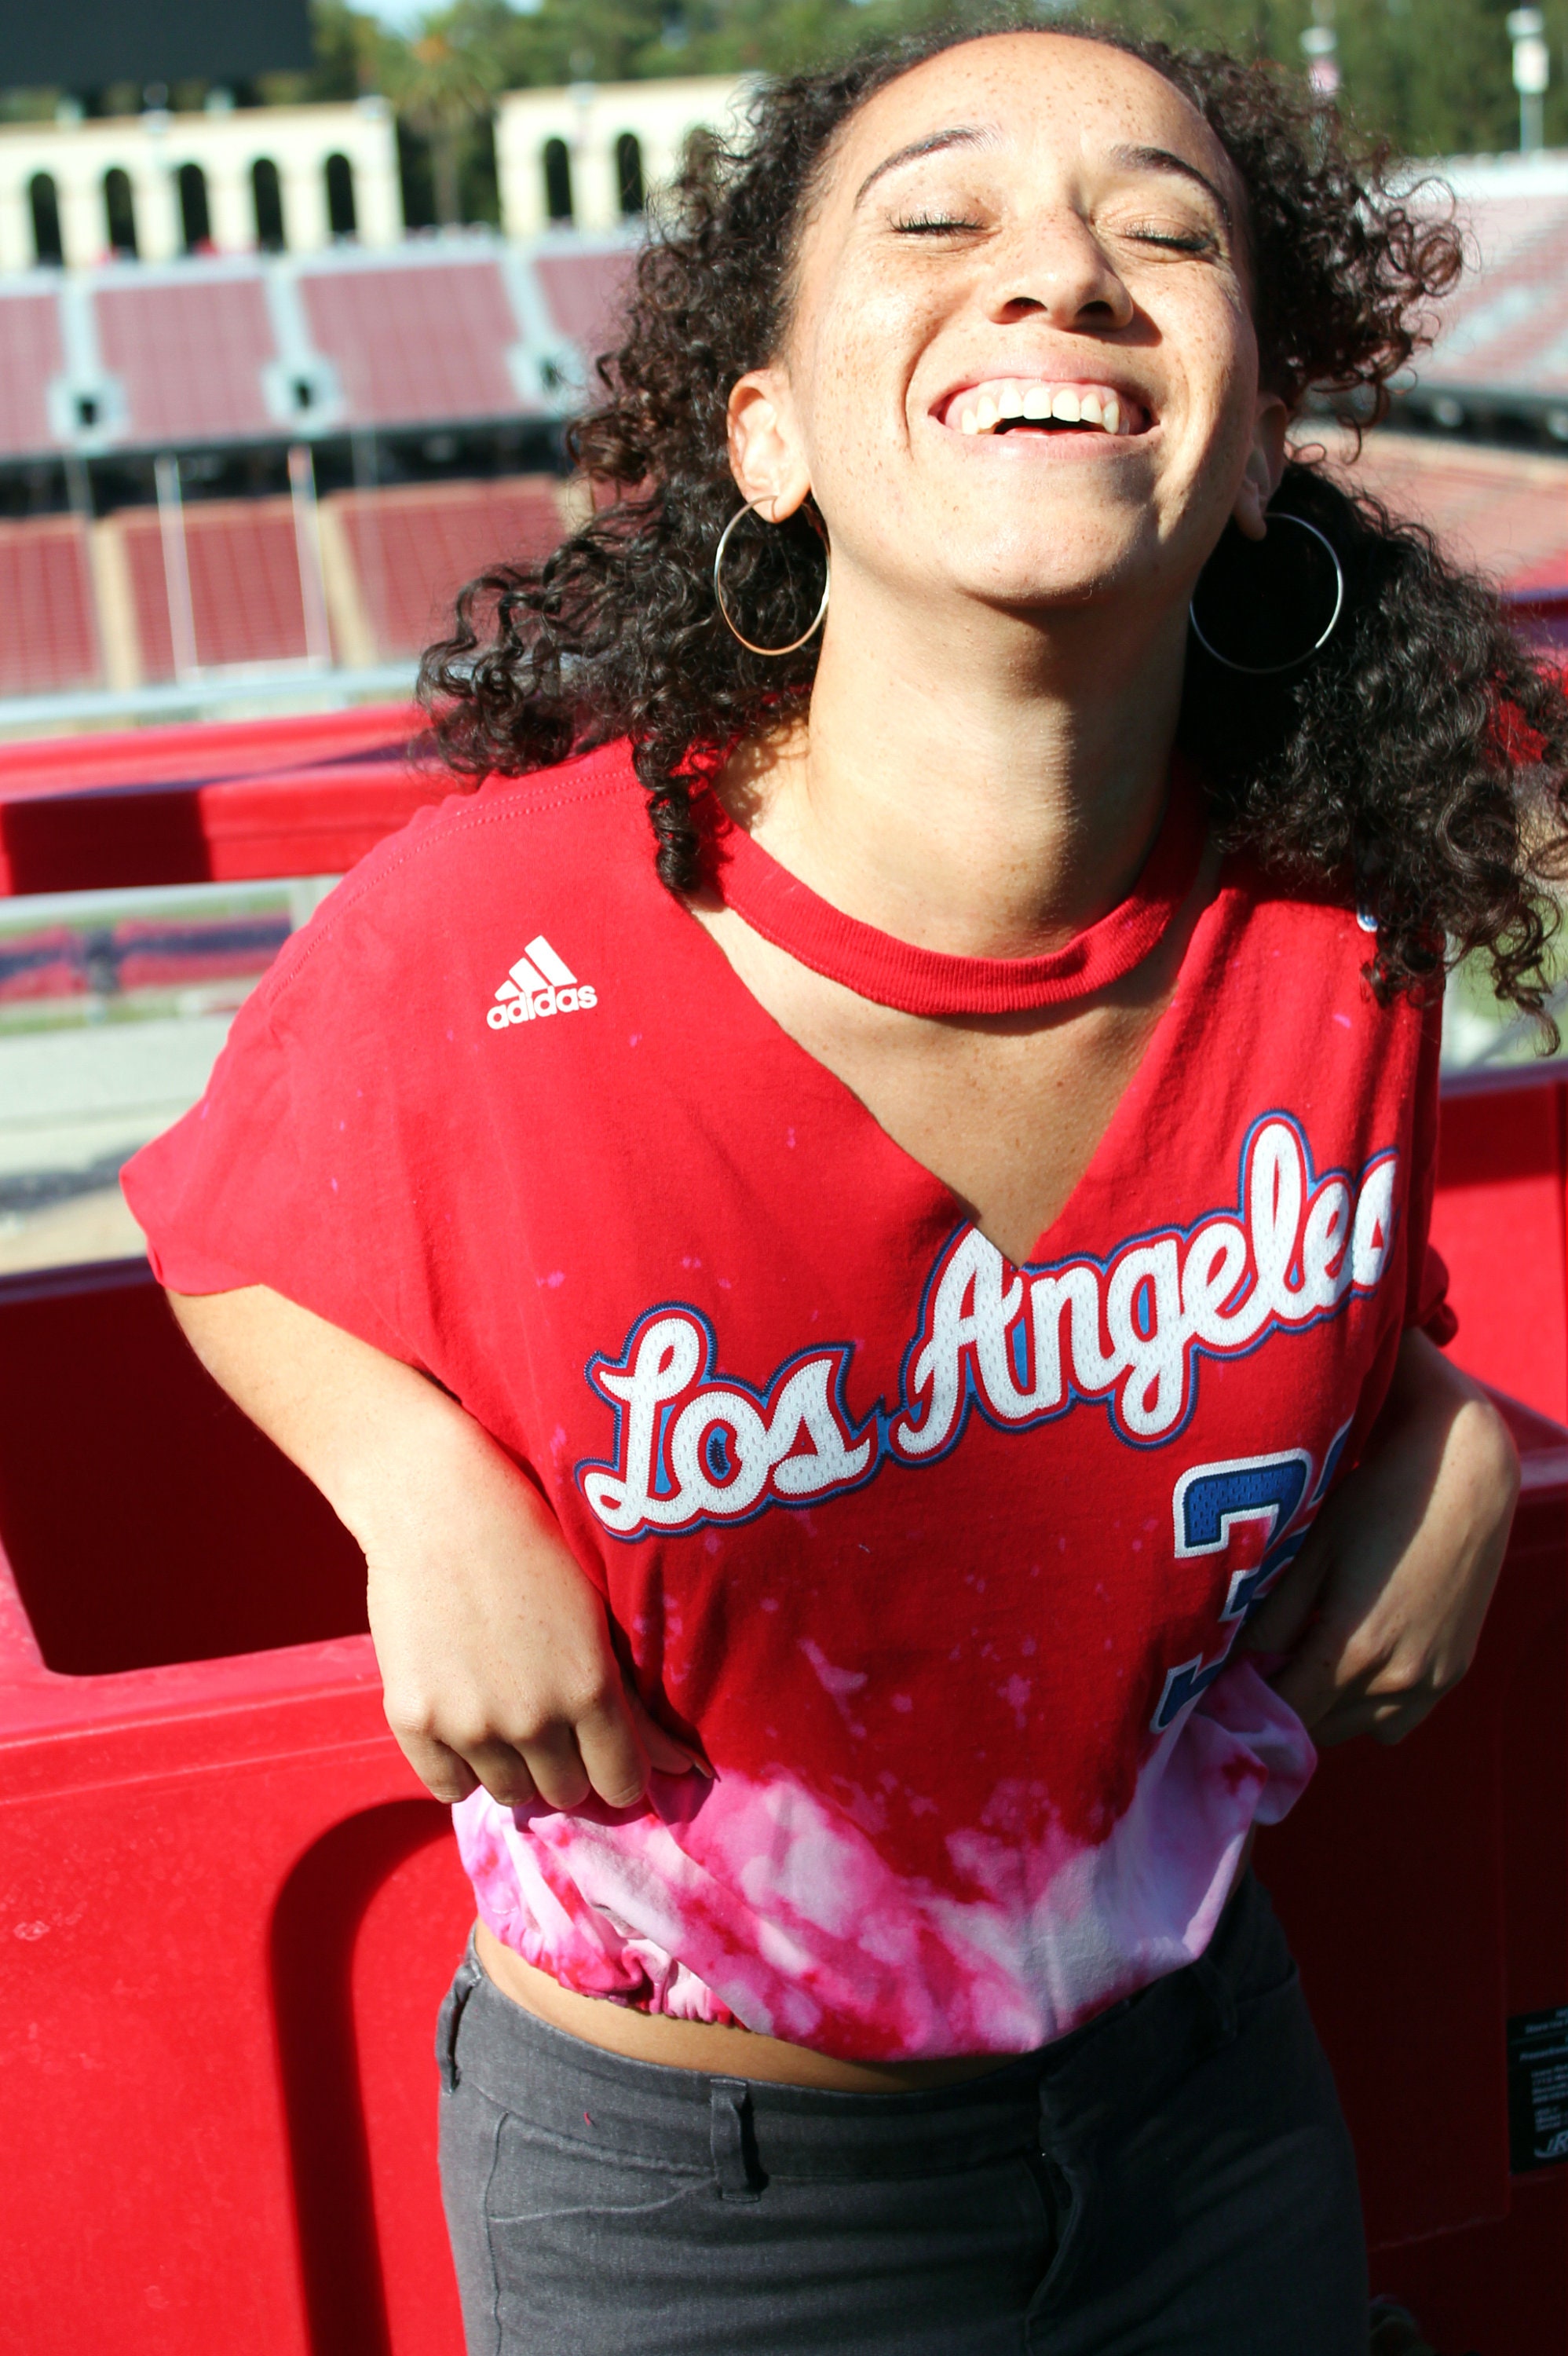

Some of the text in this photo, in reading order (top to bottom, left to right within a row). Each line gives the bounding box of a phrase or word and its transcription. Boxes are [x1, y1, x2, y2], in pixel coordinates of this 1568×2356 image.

[486, 985, 598, 1030] adidas
[579, 1117, 1398, 1536] Los Angeles
